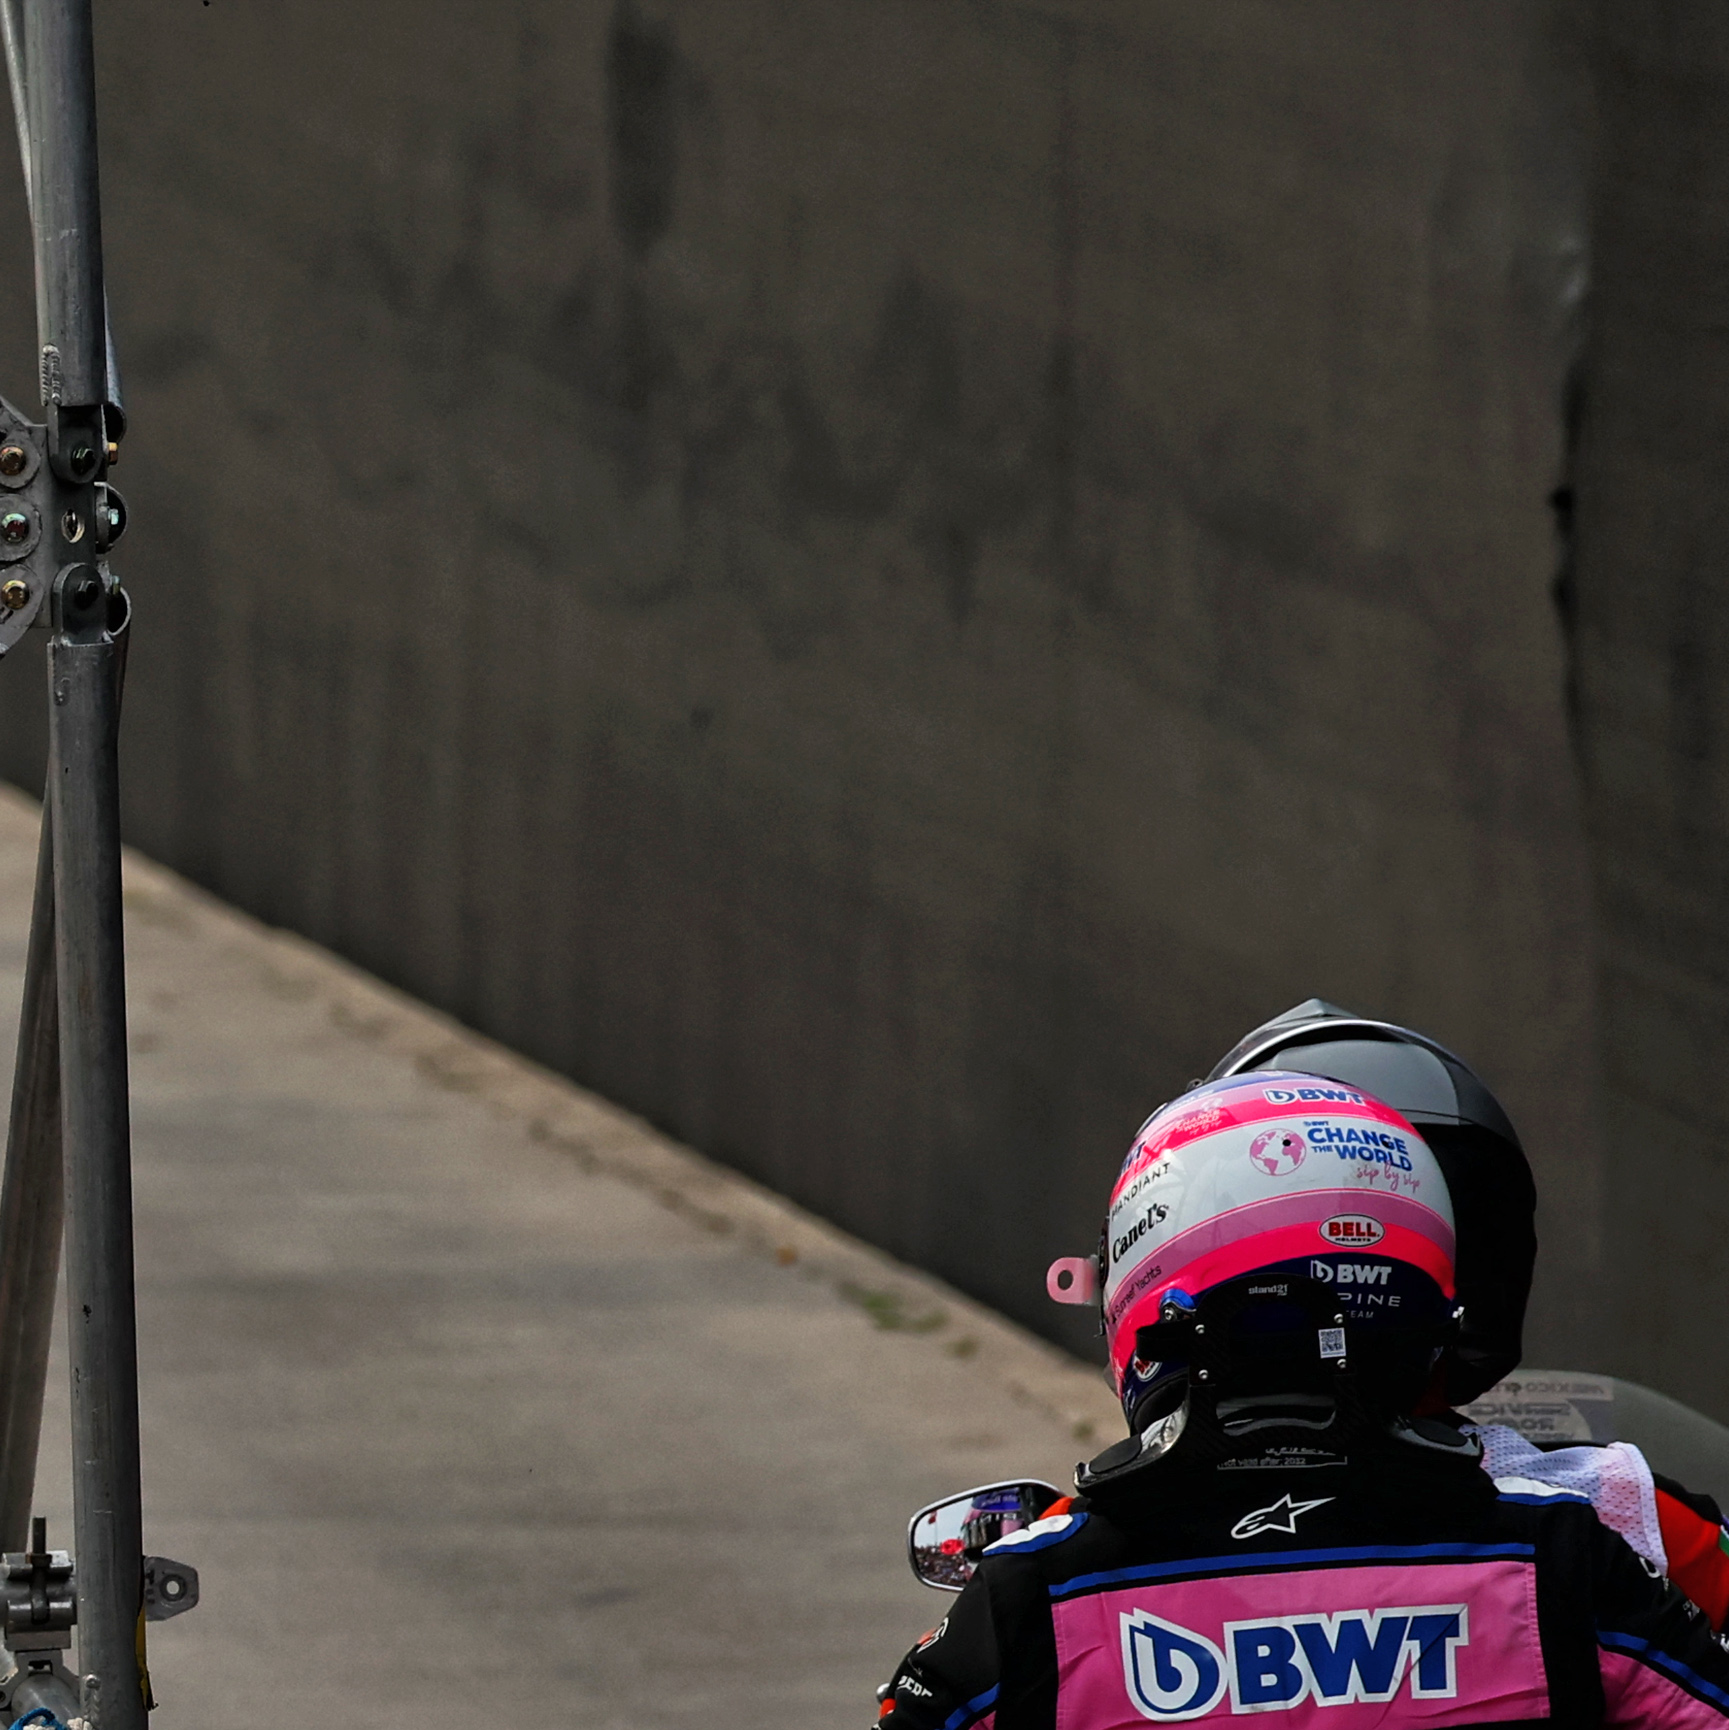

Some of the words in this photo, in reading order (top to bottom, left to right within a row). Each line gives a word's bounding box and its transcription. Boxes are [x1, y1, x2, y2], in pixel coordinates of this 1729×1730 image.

[1298, 1087, 1366, 1106] BWT
[1307, 1127, 1410, 1156] CHANGE
[1311, 1145, 1333, 1153] THE
[1335, 1145, 1413, 1172] WORLD
[1357, 1165, 1380, 1184] sip
[1384, 1158, 1400, 1192] by
[1111, 1162, 1171, 1221] MANDIANT
[1112, 1202, 1169, 1264] Canel's
[1328, 1222, 1378, 1238] BELL
[1134, 1264, 1162, 1291] Yachts
[1337, 1264, 1392, 1286] BWT
[1346, 1310, 1374, 1319] EAM
[1223, 1603, 1469, 1715] BWT
